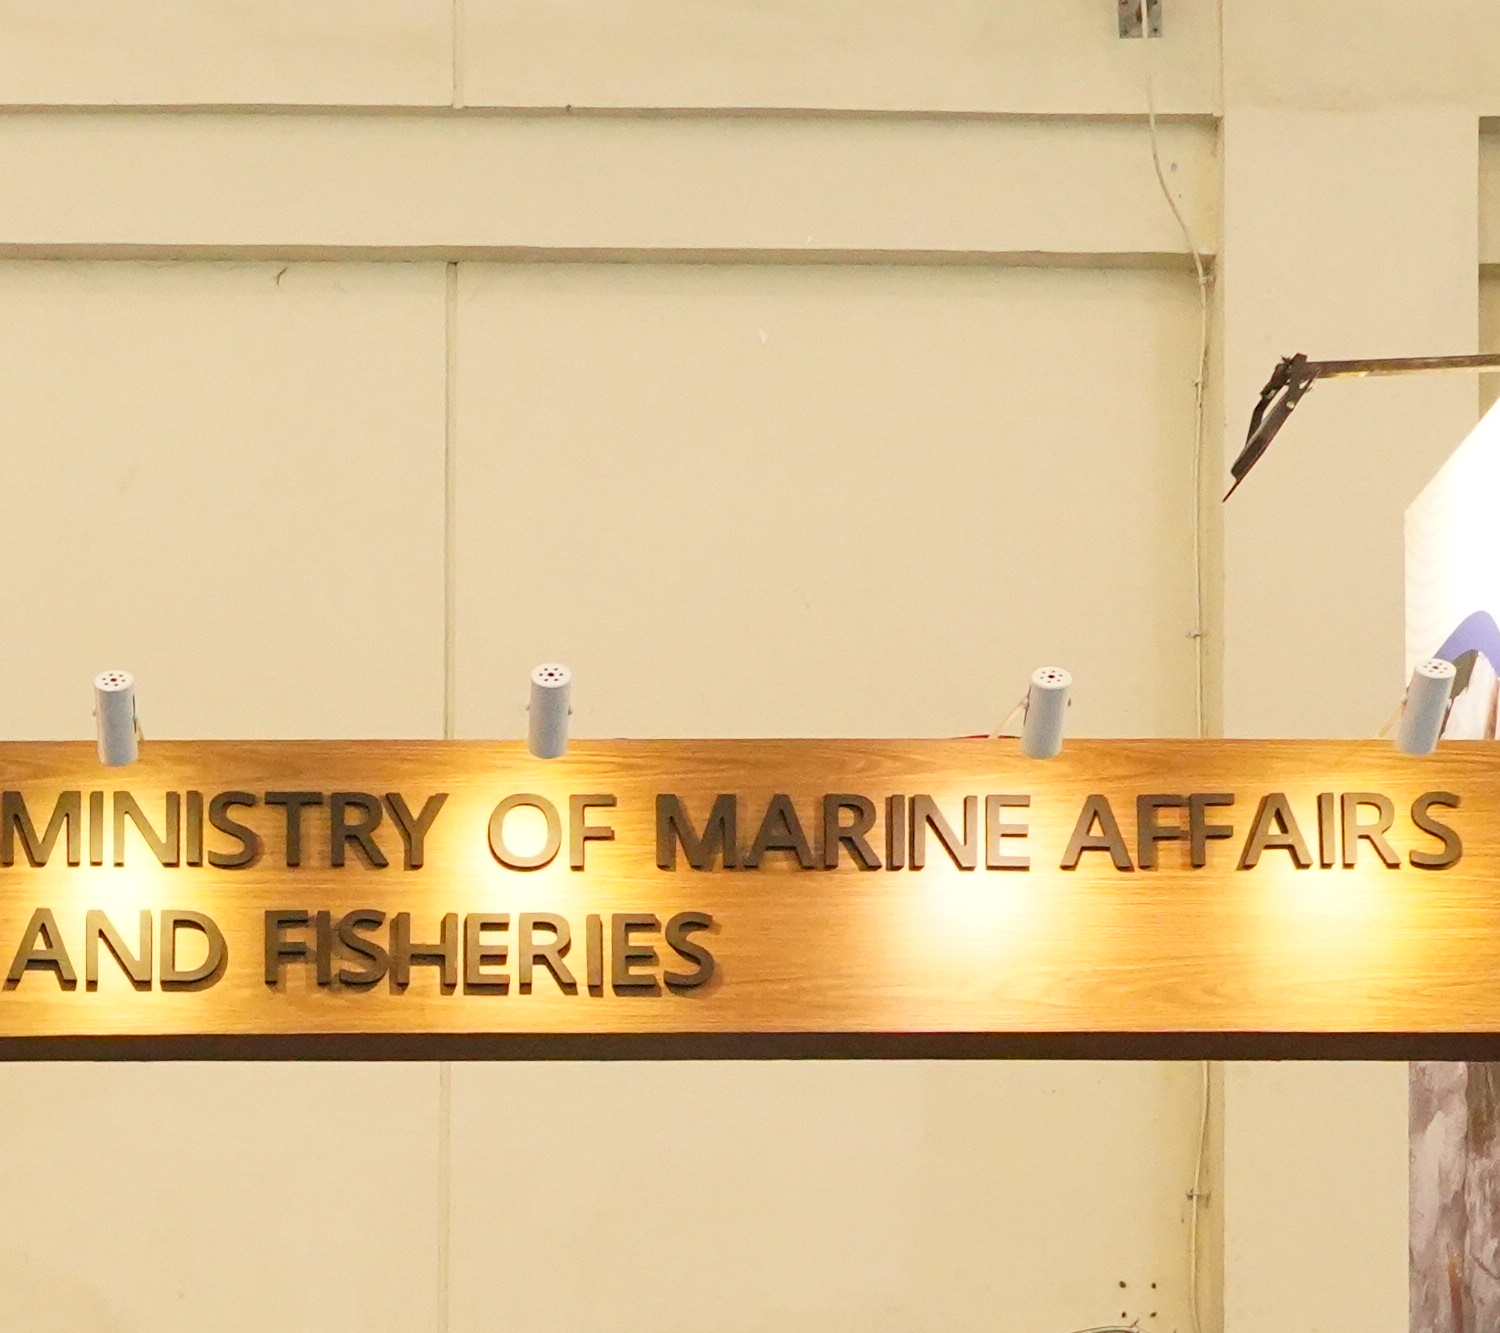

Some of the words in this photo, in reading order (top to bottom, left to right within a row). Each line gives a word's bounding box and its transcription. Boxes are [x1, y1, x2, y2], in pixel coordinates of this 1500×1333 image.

[487, 792, 617, 871] OF
[655, 794, 1030, 871] MARINE
[1061, 793, 1462, 871] AFFAIRS
[6, 907, 228, 992] AND
[264, 909, 719, 994] FISHERIES
